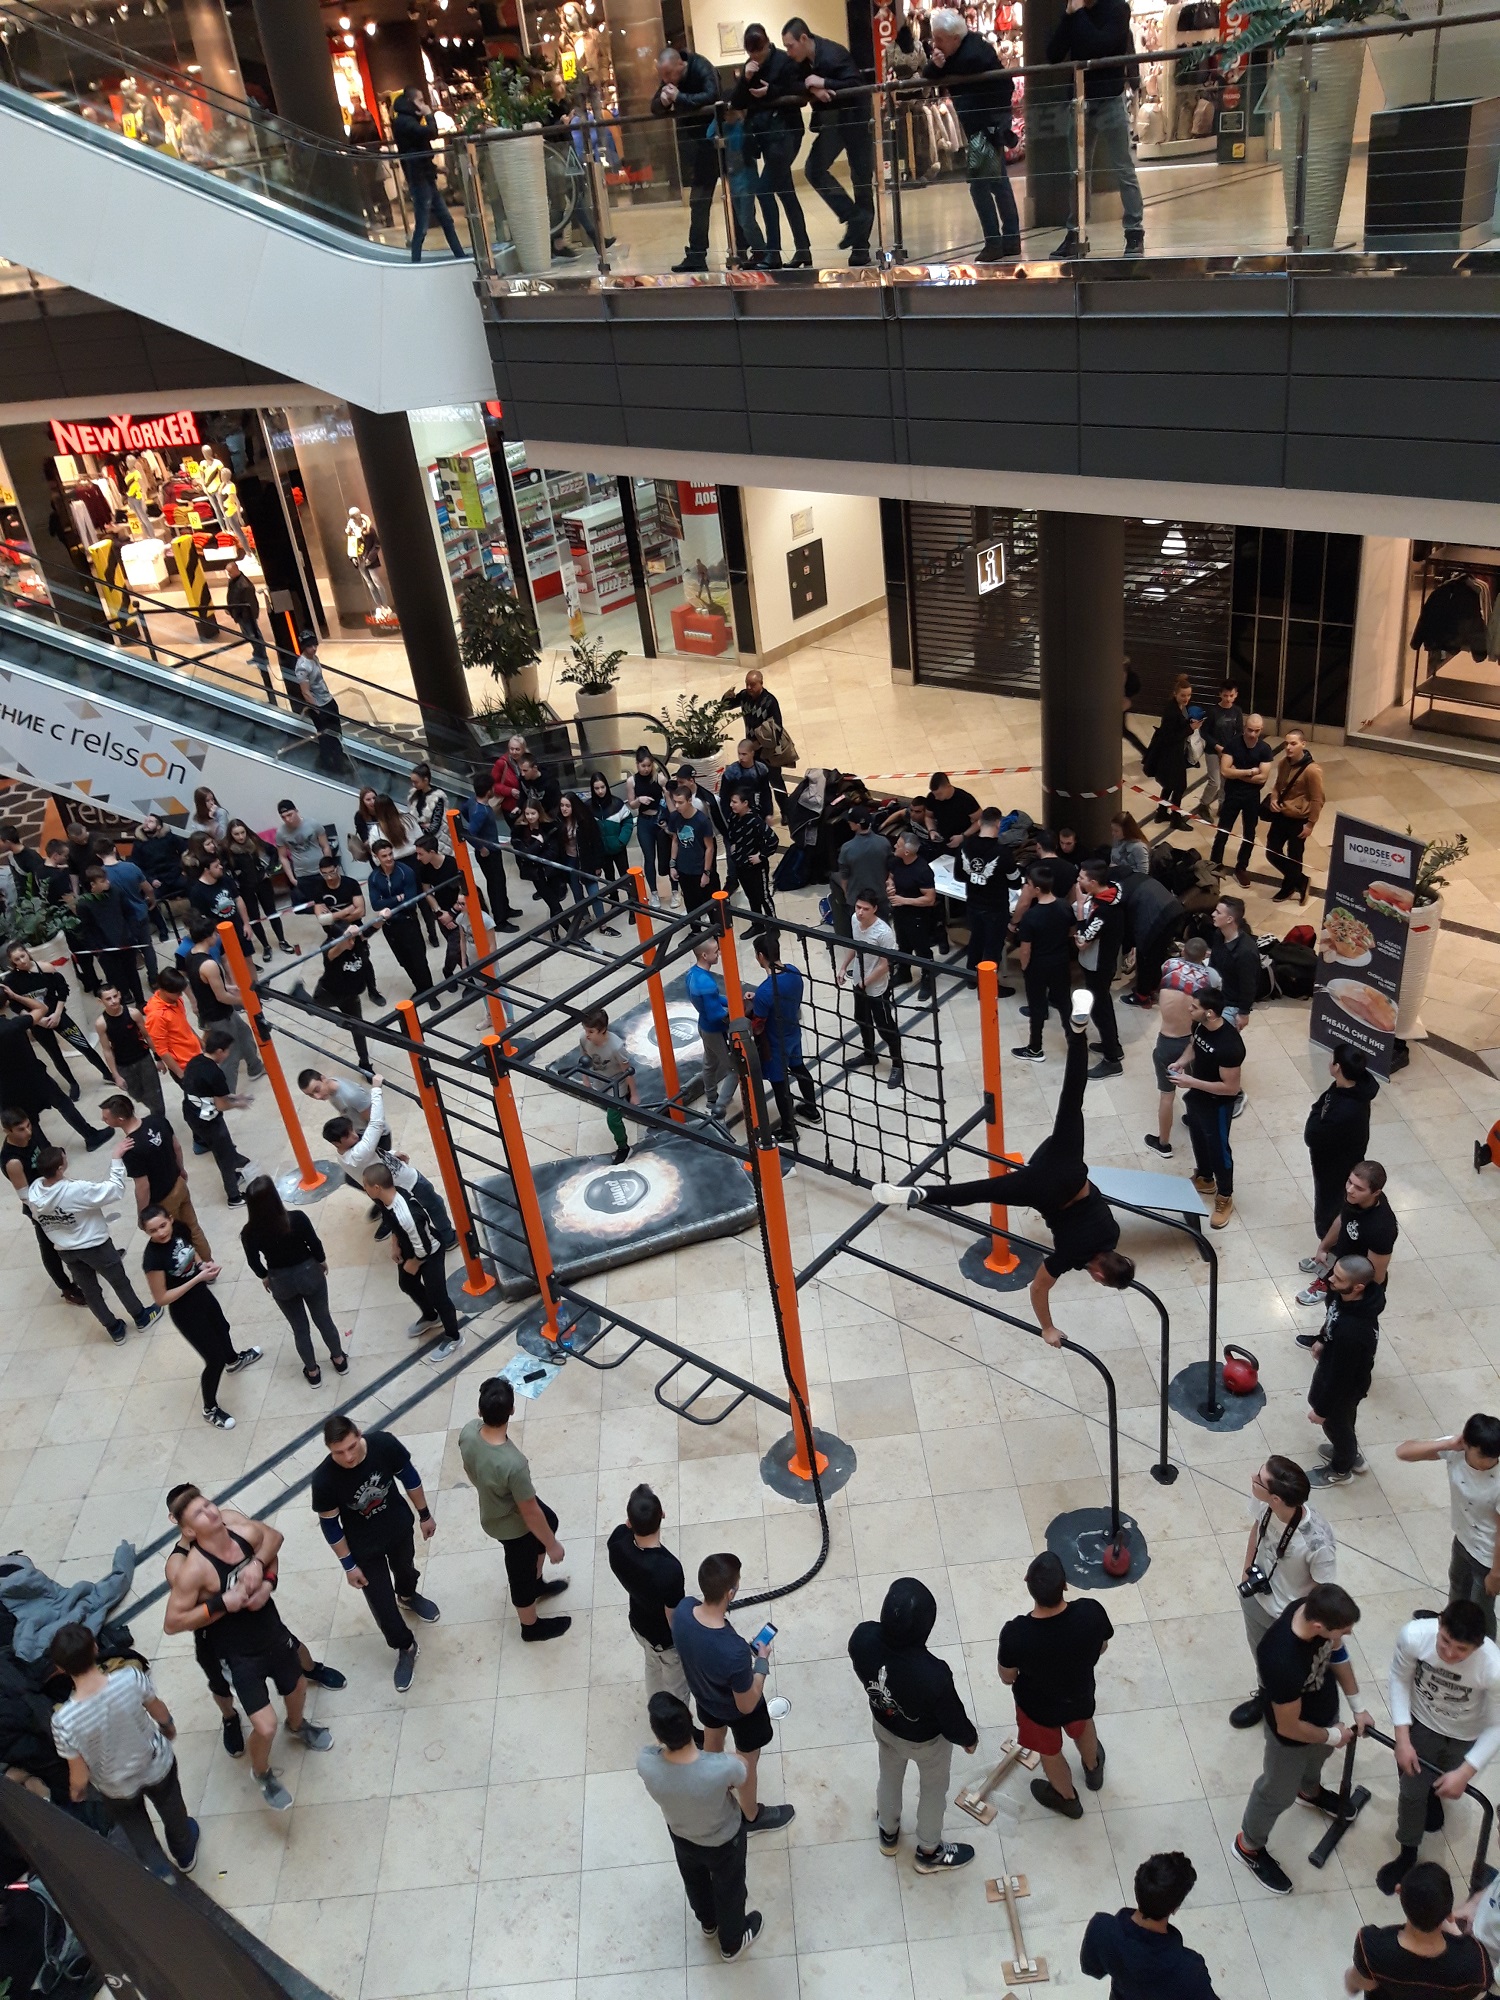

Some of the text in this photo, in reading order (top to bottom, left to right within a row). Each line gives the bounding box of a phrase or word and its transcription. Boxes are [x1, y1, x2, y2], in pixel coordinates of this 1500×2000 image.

[1349, 842, 1391, 860] NORDSEE
[1321, 1014, 1385, 1052] РИБАТА СМЕ НИЕ
